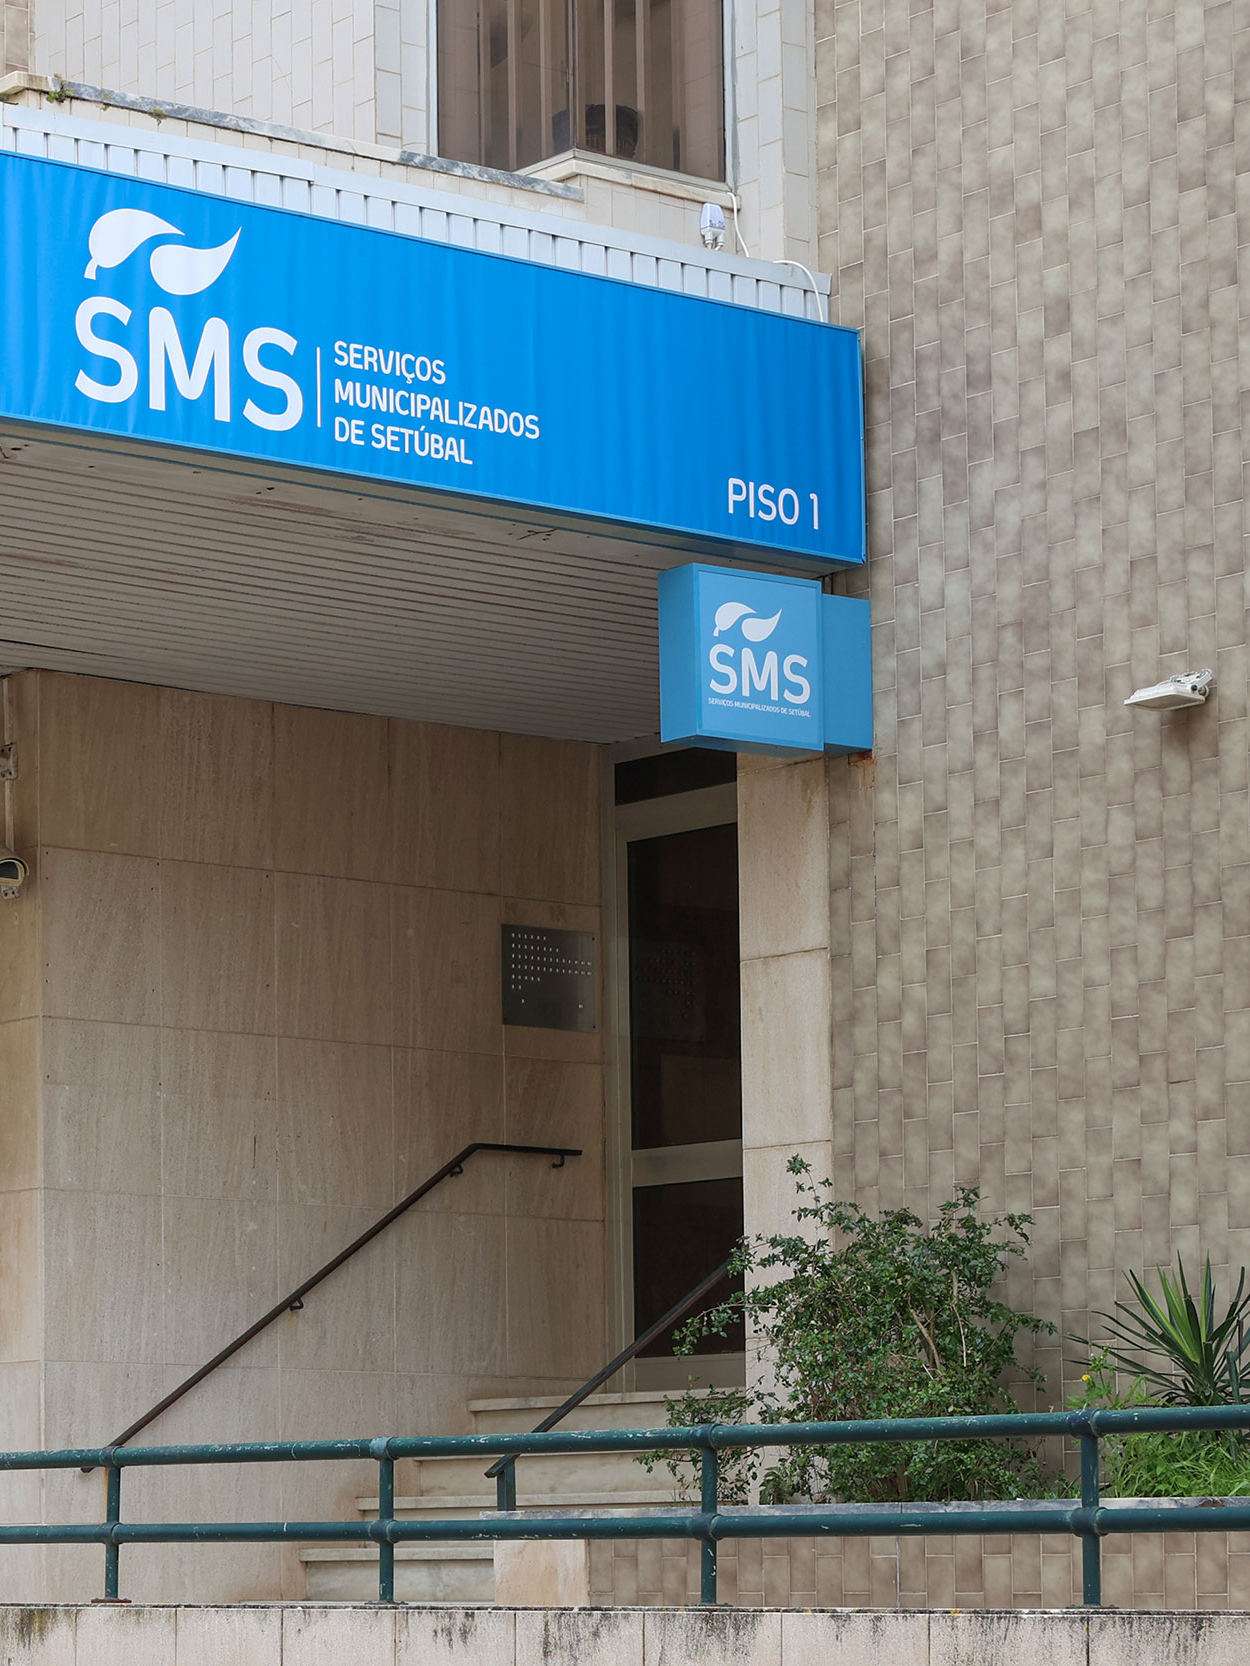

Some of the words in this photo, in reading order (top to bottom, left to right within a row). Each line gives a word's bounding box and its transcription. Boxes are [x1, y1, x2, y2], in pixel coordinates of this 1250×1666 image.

[74, 296, 304, 432] SMS
[334, 340, 447, 386] SERVIÇOS
[334, 378, 540, 440] MUNICIPALIZADOS
[334, 416, 365, 446] DE
[371, 423, 473, 465] SETÚBAL
[728, 477, 800, 525] PISO
[809, 493, 819, 530] 1
[709, 643, 811, 705] SMS
[708, 697, 734, 708] SERVIÇOS
[734, 701, 780, 714] MUNICIPALIZADOS
[780, 707, 788, 715] DE
[788, 707, 811, 718] SETÚBAL
